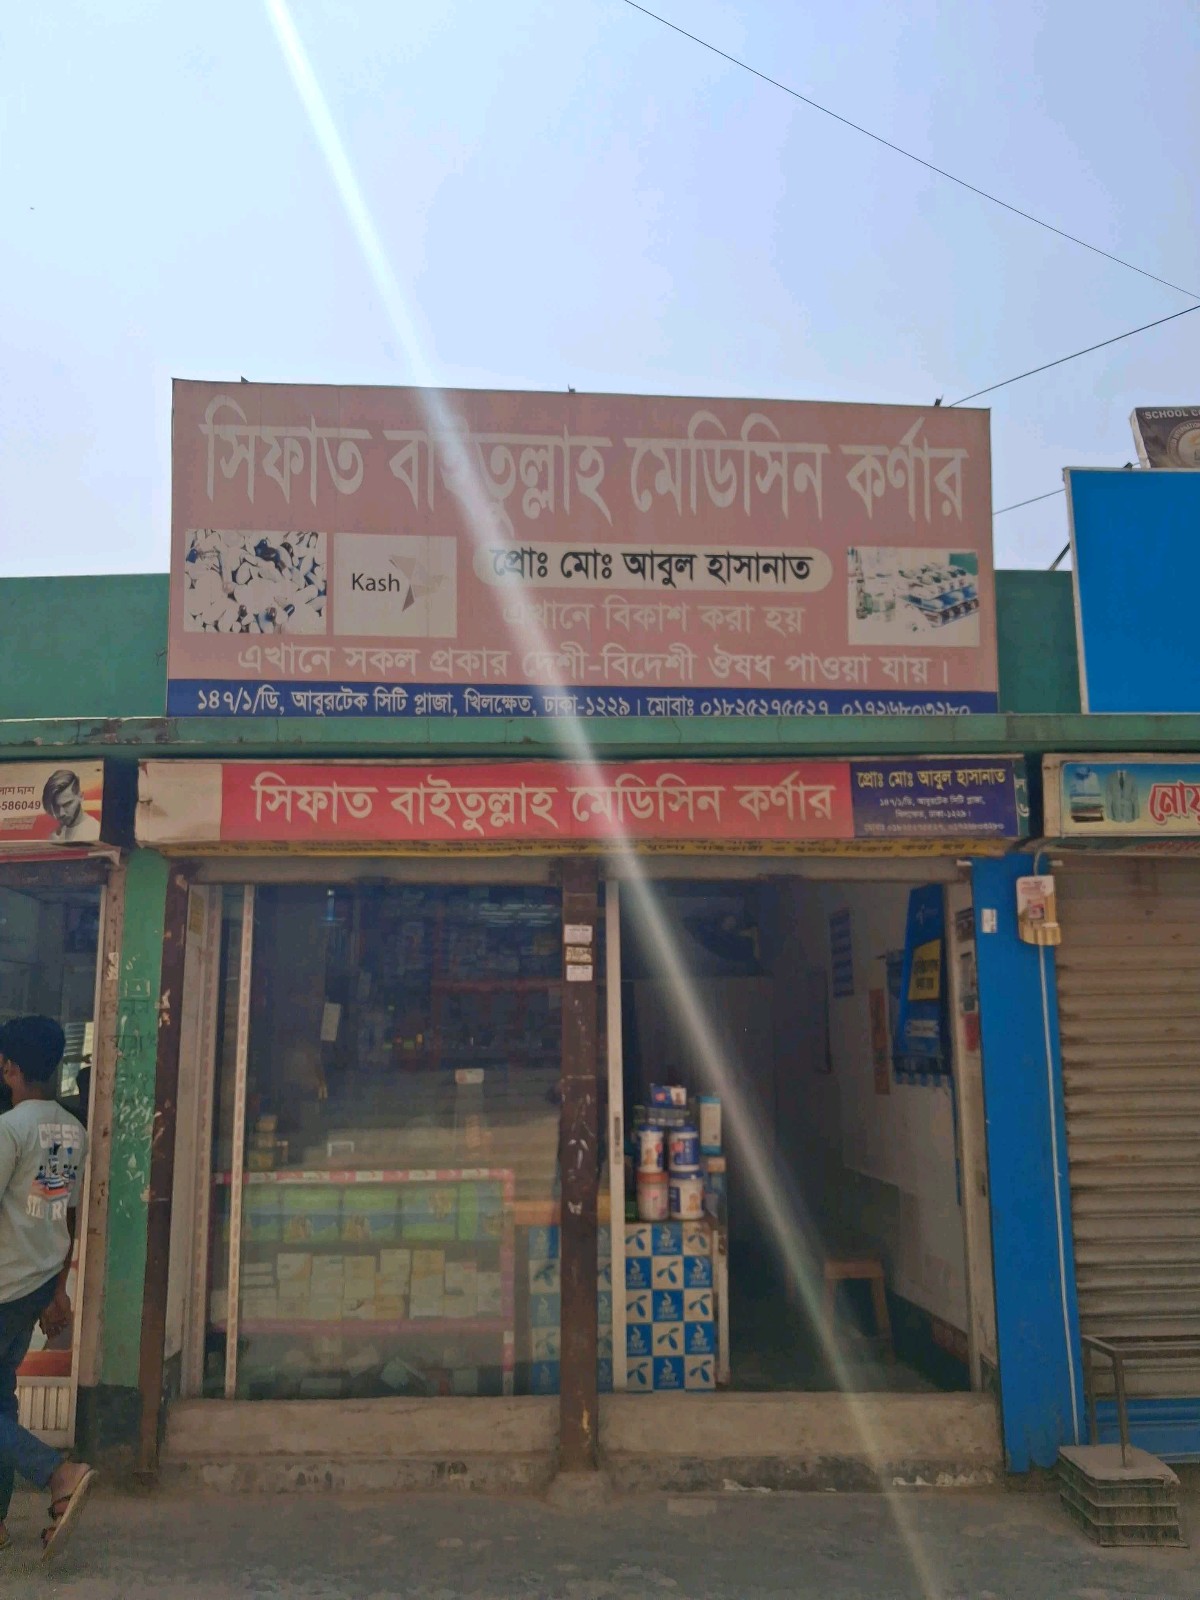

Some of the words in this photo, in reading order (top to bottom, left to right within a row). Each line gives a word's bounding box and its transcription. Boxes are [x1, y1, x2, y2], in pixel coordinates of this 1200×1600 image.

[198, 394, 372, 508] সিফাত
[623, 410, 830, 520] মেডিসিন
[838, 416, 969, 523] কর্ণার
[351, 572, 400, 593] Kash
[492, 547, 548, 580] প্রোঃ
[560, 548, 612, 581] মোঃ
[621, 548, 697, 589] আবুল
[704, 551, 813, 586] হাসানাত
[602, 594, 690, 635] বিকাশ
[697, 602, 755, 635] করা
[761, 604, 806, 638] হয়
[238, 642, 335, 676] এখানে
[342, 646, 421, 677] সকল
[429, 646, 511, 679] প্রকার
[708, 644, 776, 682] ঔষধ
[785, 650, 871, 683] পাওয়া
[878, 652, 932, 685] যায়
[373, 686, 409, 713] সিটি
[646, 695, 695, 717] মোবাঃ
[856, 770, 885, 789] প্রোঃ
[888, 770, 914, 788] মোঃ
[917, 770, 952, 791] আবুল
[956, 769, 1006, 787] হাসানাত
[250, 771, 379, 824] সিফাত
[386, 773, 560, 837] বাইতুল্লাহ
[566, 773, 727, 824] মেডিসিন
[733, 771, 838, 823] কর্ণার
